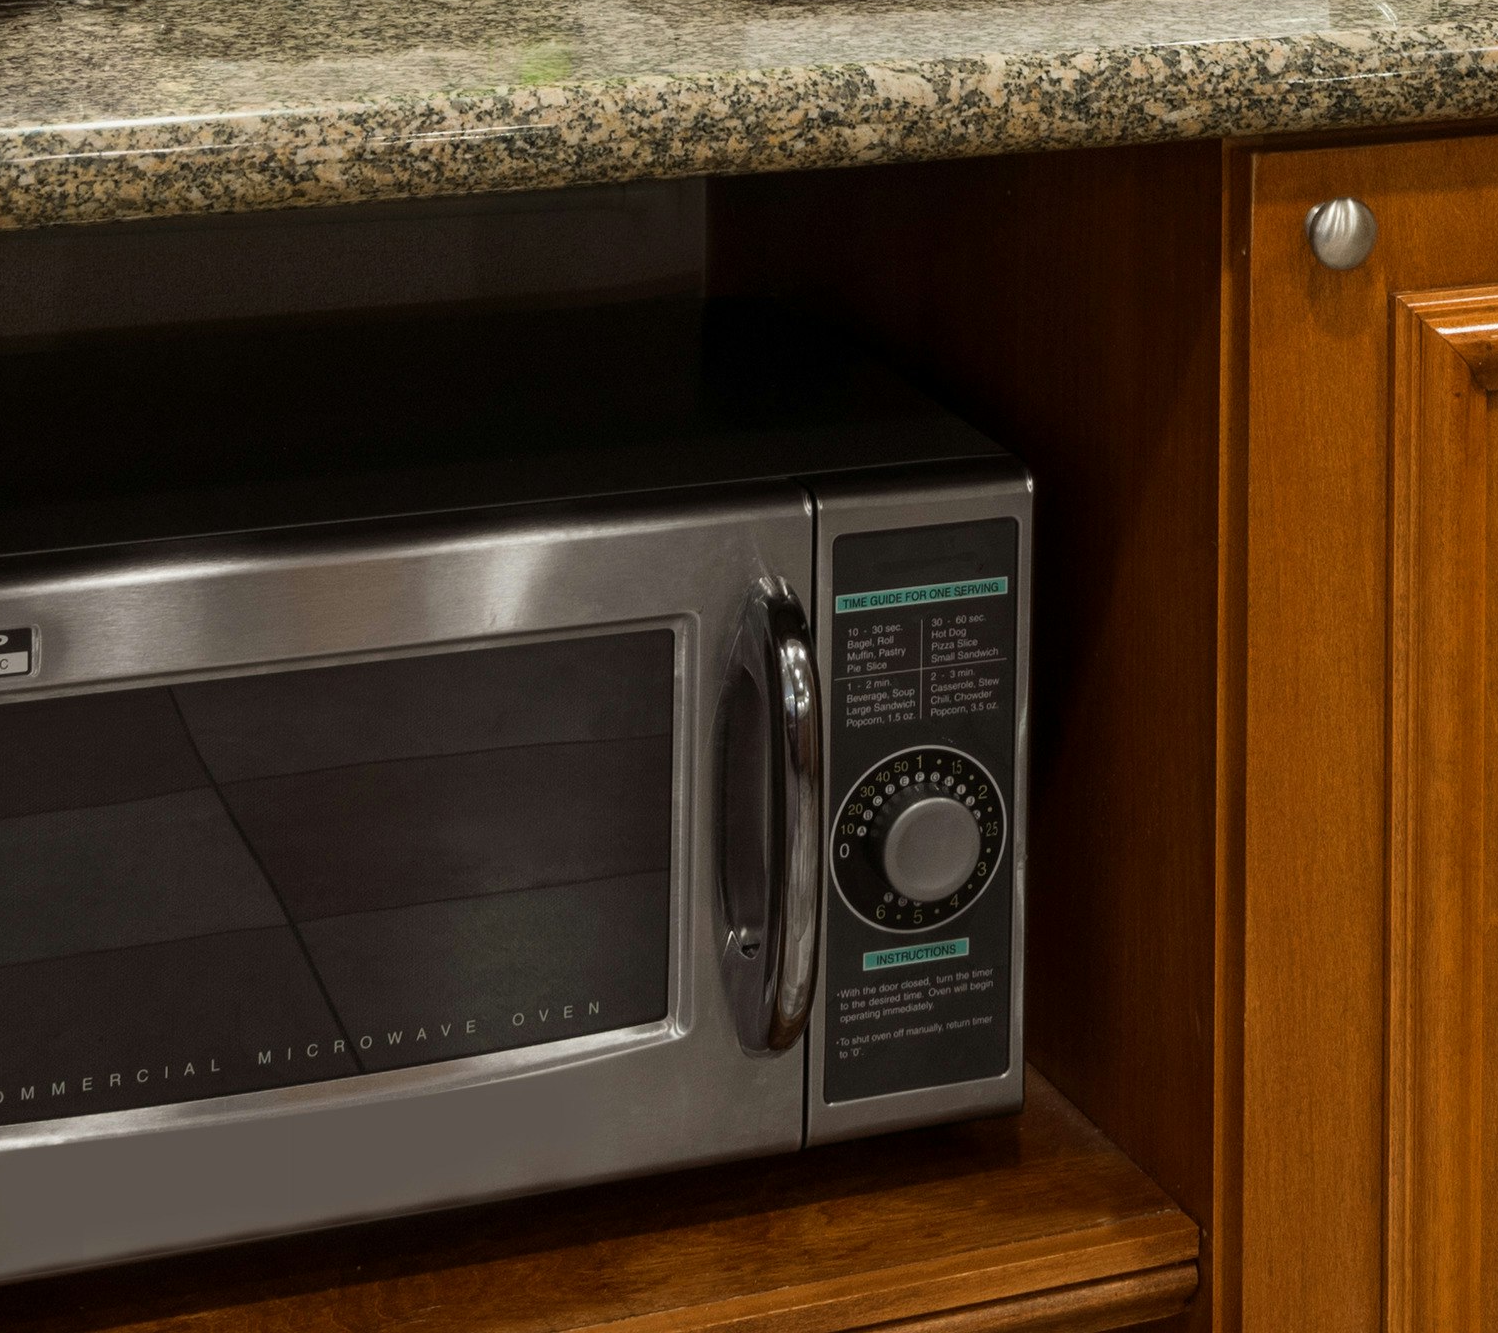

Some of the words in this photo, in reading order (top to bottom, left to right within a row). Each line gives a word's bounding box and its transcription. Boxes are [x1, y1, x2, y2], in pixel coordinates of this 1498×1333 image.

[842, 596, 868, 609] TIME
[869, 593, 902, 607] GUIDE
[904, 591, 927, 602] FOR
[929, 587, 951, 599] ONE
[953, 582, 999, 596] SERVING
[931, 618, 942, 627] 30
[955, 615, 967, 624] 60
[847, 627, 858, 637] 10
[871, 624, 883, 634] 30
[931, 629, 947, 639] Hot
[949, 628, 967, 638] Dog
[877, 635, 895, 645] Roll
[931, 641, 955, 651] Pizza
[957, 638, 978, 648] Slice
[878, 648, 907, 658] Pastry
[931, 652, 955, 664] Small
[957, 647, 999, 659] Sandwich
[847, 663, 861, 673] Pie
[866, 661, 887, 671] Slice
[930, 671, 936, 681] 2
[949, 670, 956, 679] 3
[978, 677, 1000, 687] Stew
[866, 680, 872, 689] 2
[892, 688, 915, 698] Soup
[954, 690, 992, 702] Chowder
[846, 704, 871, 717] Large
[874, 699, 916, 712] Sandwich
[971, 702, 984, 712] 3.5
[888, 713, 900, 722] 1.5
[893, 760, 909, 773] 50
[915, 754, 922, 770] 1
[875, 770, 891, 783] 40
[860, 784, 875, 798] 30
[977, 784, 988, 800] 2
[847, 803, 863, 816] 20
[840, 823, 855, 835] 10
[839, 842, 850, 859] 0
[976, 860, 987, 877] 3
[949, 893, 960, 908] 4
[875, 903, 887, 920] 6
[913, 909, 923, 925] 5
[876, 943, 957, 966] INSTRUCTIONS
[863, 986, 876, 996] the
[878, 982, 899, 994] door
[936, 975, 953, 984] turn
[955, 972, 969, 981] the
[971, 967, 994, 979] timer
[840, 1002, 849, 1011] to
[852, 999, 866, 1009] the
[868, 994, 901, 1007] desired
[928, 986, 951, 997] Oven
[953, 983, 968, 994] will
[970, 979, 994, 992] begin
[839, 1009, 881, 1025] operating
[257, 1019, 477, 1066] MICROWAVE
[511, 1001, 601, 1027] OVEN
[852, 1034, 870, 1045] shut
[871, 1032, 891, 1042] oven
[893, 1028, 904, 1038] off
[946, 1018, 971, 1030] return
[972, 1014, 993, 1026] timer
[839, 1049, 848, 1059] to
